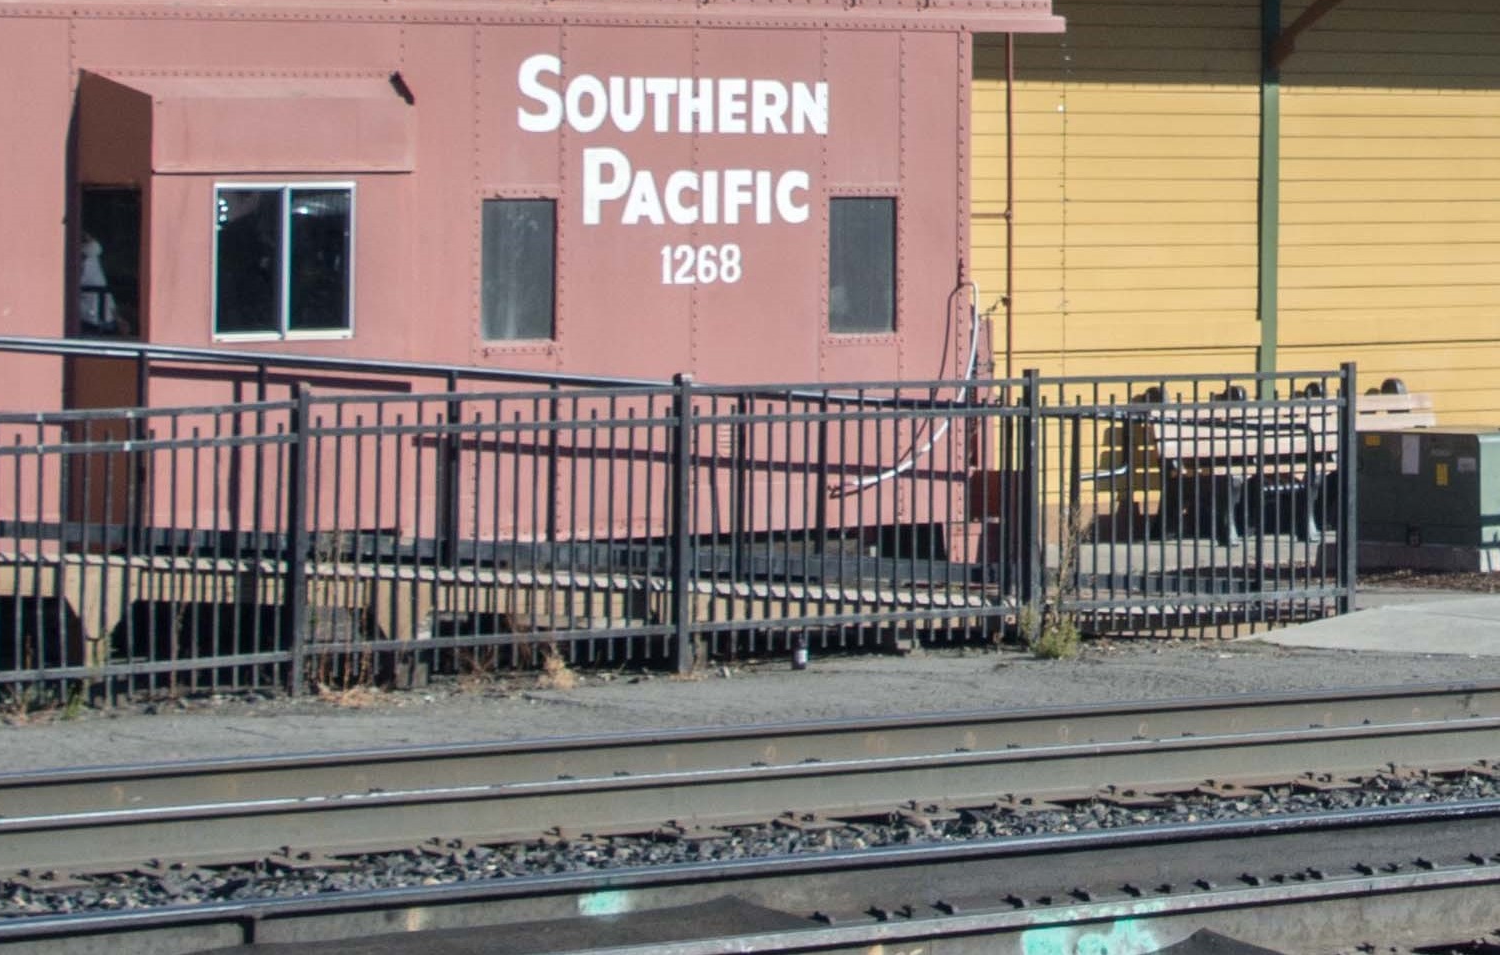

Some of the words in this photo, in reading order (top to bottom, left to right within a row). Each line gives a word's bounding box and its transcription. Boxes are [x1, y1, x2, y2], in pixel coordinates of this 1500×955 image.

[517, 53, 829, 135] SOUTHERN
[582, 147, 810, 226] PACIFIC
[660, 243, 743, 285] 1268
